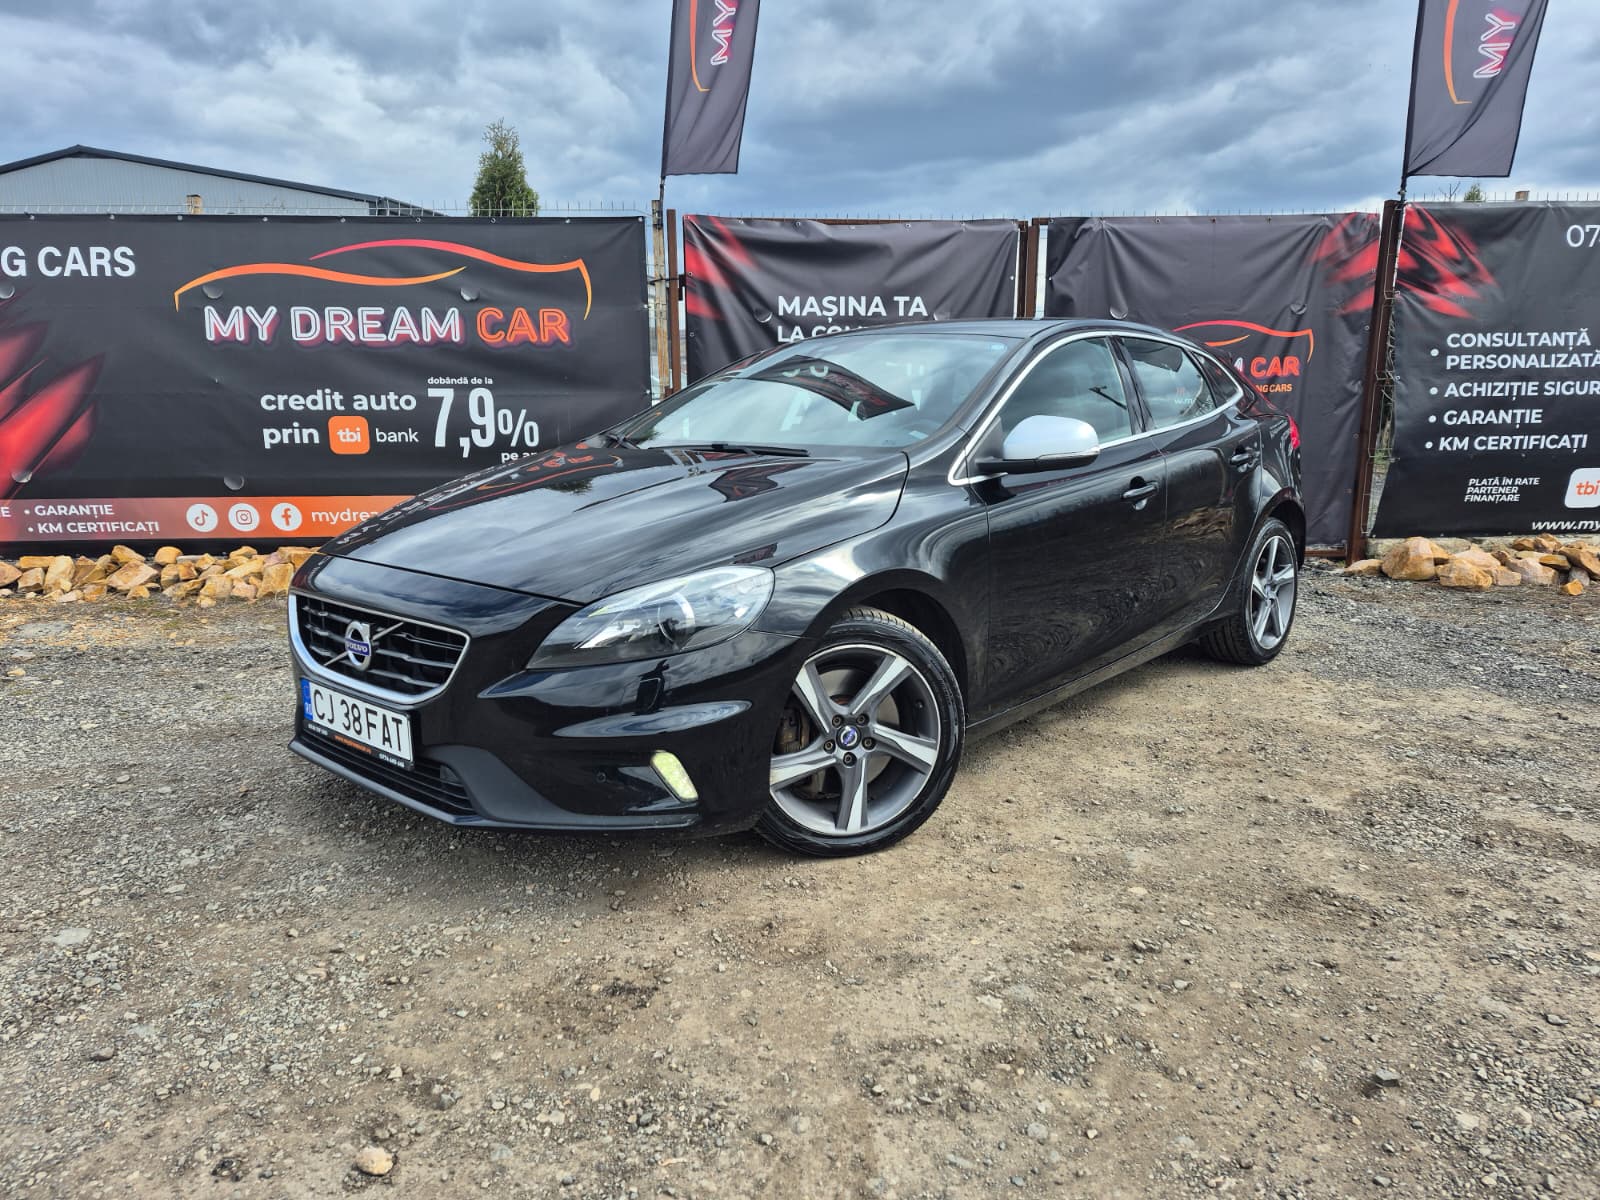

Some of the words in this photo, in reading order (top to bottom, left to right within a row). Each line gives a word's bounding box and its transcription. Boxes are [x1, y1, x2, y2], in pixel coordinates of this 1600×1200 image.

[710, 0, 737, 66] MY
[1472, 13, 1516, 79] MY
[37, 246, 136, 277] CARS
[777, 295, 887, 323] MAȘINA
[893, 296, 929, 317] TA
[203, 305, 278, 342] MY
[290, 306, 461, 343] DREAM
[476, 307, 570, 344] CAR
[776, 325, 806, 343] LA
[1446, 327, 1592, 351] CONSULTANȚĂ
[1250, 356, 1301, 378] CAR
[427, 376, 469, 385] dobândă
[470, 376, 483, 385] de
[484, 376, 494, 385] la
[1269, 383, 1293, 393] CARS
[260, 388, 345, 411] credit
[353, 393, 417, 411] auto
[1444, 381, 1540, 401] ACHIZIȚIE
[1443, 408, 1543, 429] GARANȚIE
[262, 422, 320, 449] prin
[336, 428, 362, 443] tbi
[375, 428, 420, 443] bank
[1438, 436, 1470, 451] KM
[1473, 433, 1589, 453] CERTIFICAȚI
[500, 451, 519, 464] pe
[1466, 486, 1519, 494] PARTENER
[1468, 476, 1500, 486] PLATĂ
[1501, 476, 1513, 486] ÎN
[1514, 477, 1541, 486] RATE
[1575, 480, 1600, 496] tbi
[1464, 494, 1521, 504] FINANȚARE
[34, 504, 115, 518] GARANȚIE
[37, 522, 63, 534] KM
[66, 521, 160, 535] CERTIFICAȚI
[313, 689, 335, 725] CJ
[340, 699, 363, 736] 38
[365, 707, 403, 753] FAT
